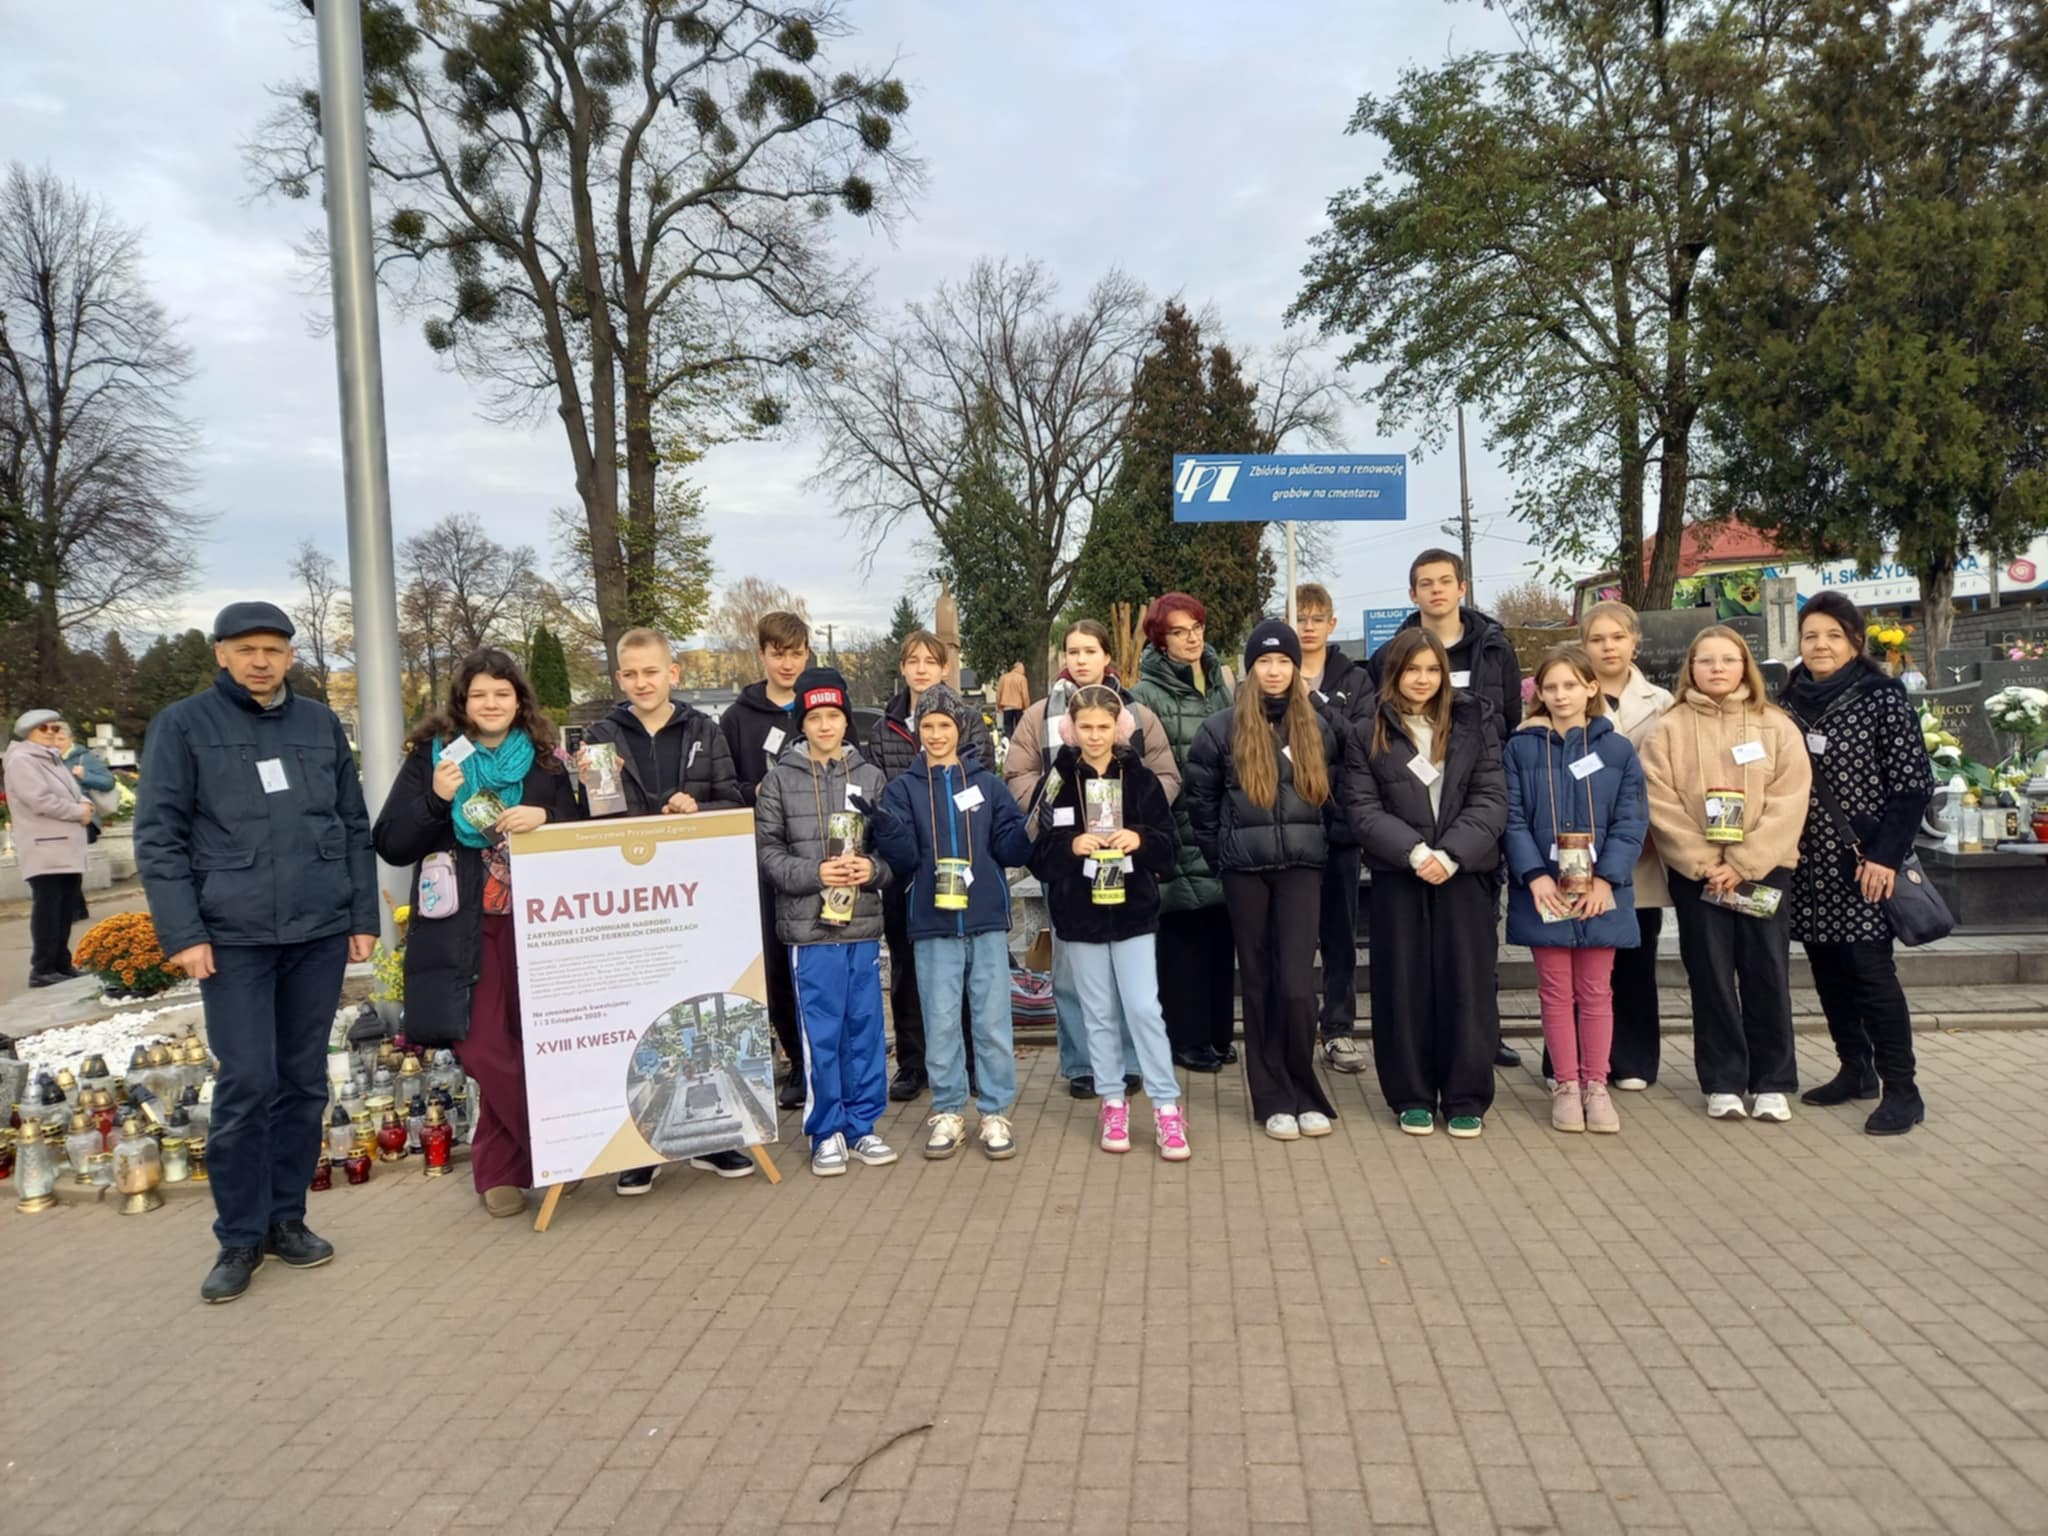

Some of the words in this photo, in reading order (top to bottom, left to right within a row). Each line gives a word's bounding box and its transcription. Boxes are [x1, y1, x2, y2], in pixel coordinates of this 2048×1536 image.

[1249, 465, 1287, 477] Zbiórka
[1288, 464, 1335, 478] publiczna
[1338, 465, 1351, 474] na
[1352, 462, 1404, 477] renowację
[1272, 487, 1311, 502] grobów
[1314, 488, 1326, 499] na
[1327, 487, 1381, 499] cmentarzu
[1821, 570, 1837, 586] H.
[810, 692, 837, 705] DUDE
[526, 881, 699, 925] RATUJEMY
[536, 1038, 573, 1055] XVIII
[576, 1028, 637, 1049] KWESTA
